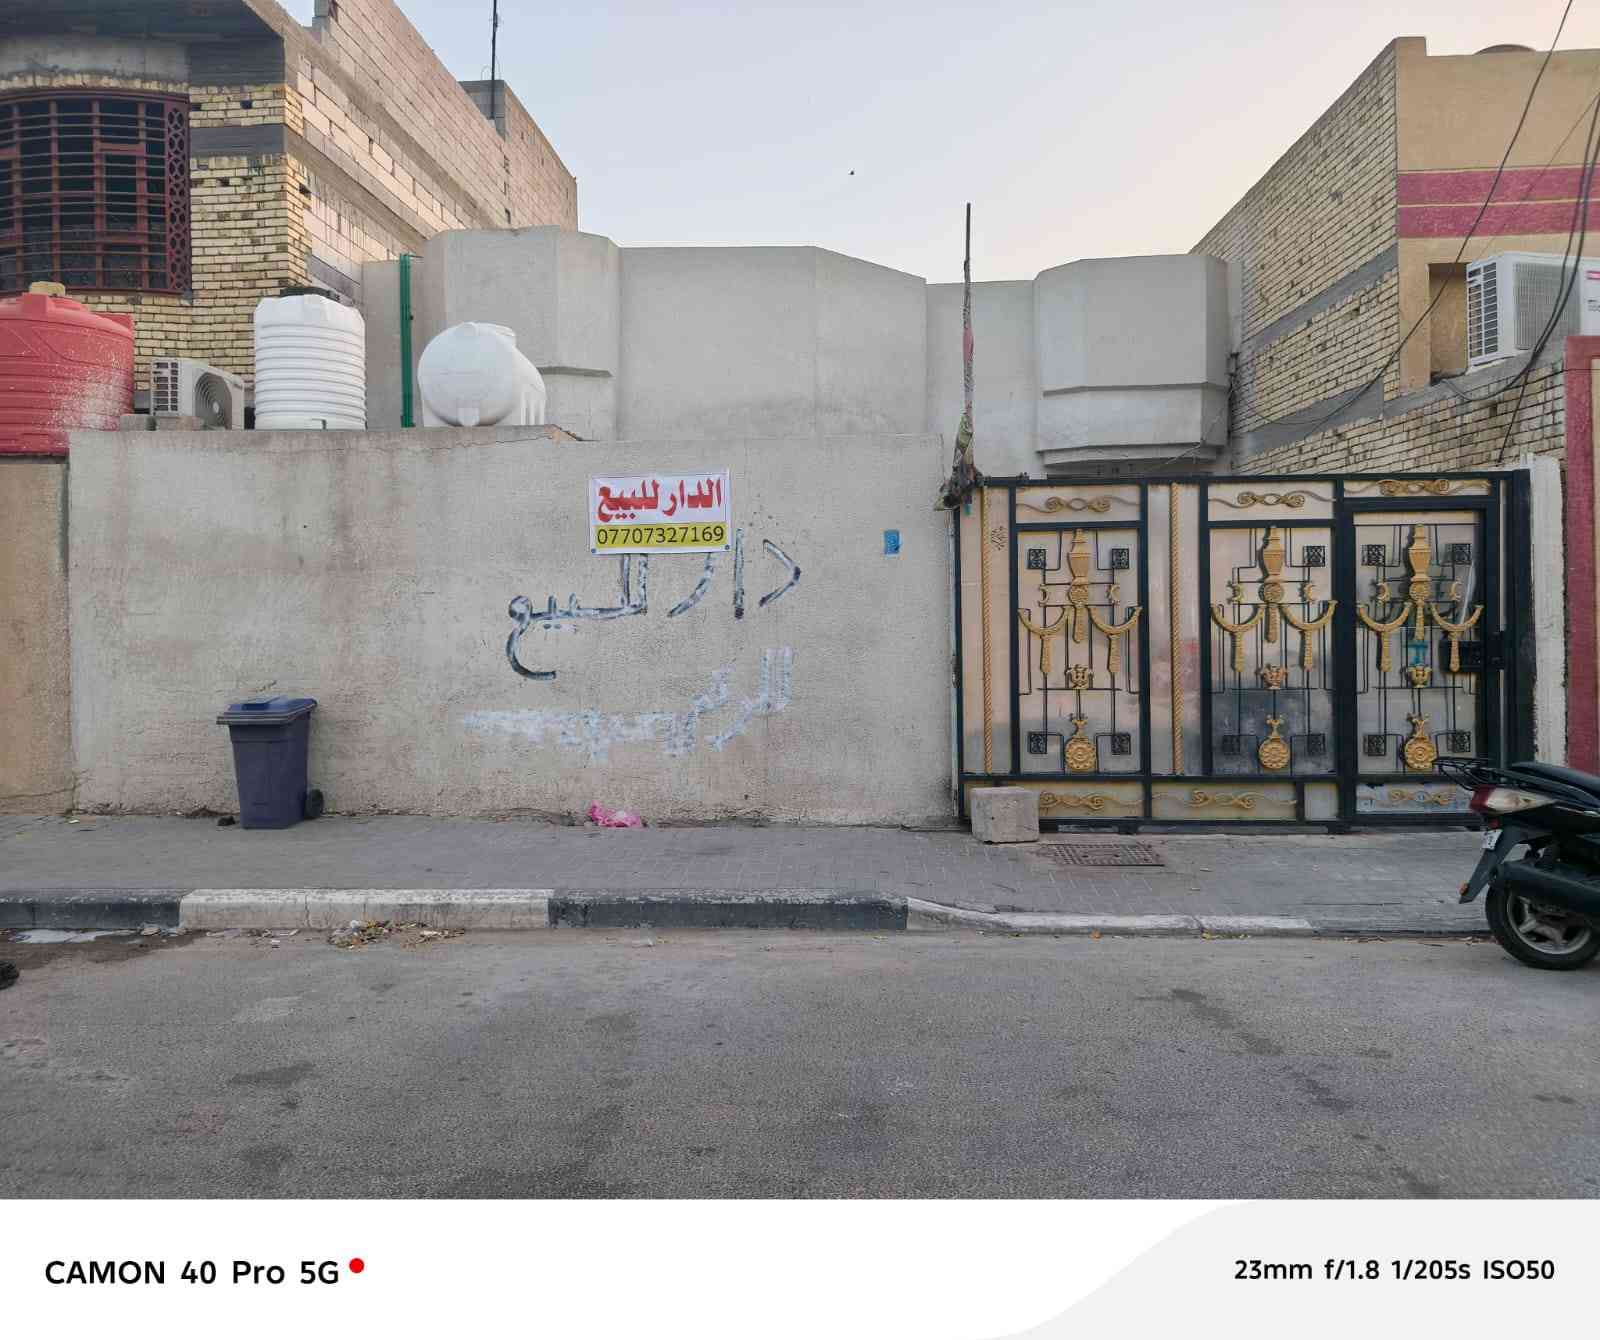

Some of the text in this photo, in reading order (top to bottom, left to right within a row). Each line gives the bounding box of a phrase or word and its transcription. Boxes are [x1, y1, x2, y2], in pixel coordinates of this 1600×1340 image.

[598, 478, 722, 523] الدار للبيع
[597, 526, 725, 545] 07707327169
